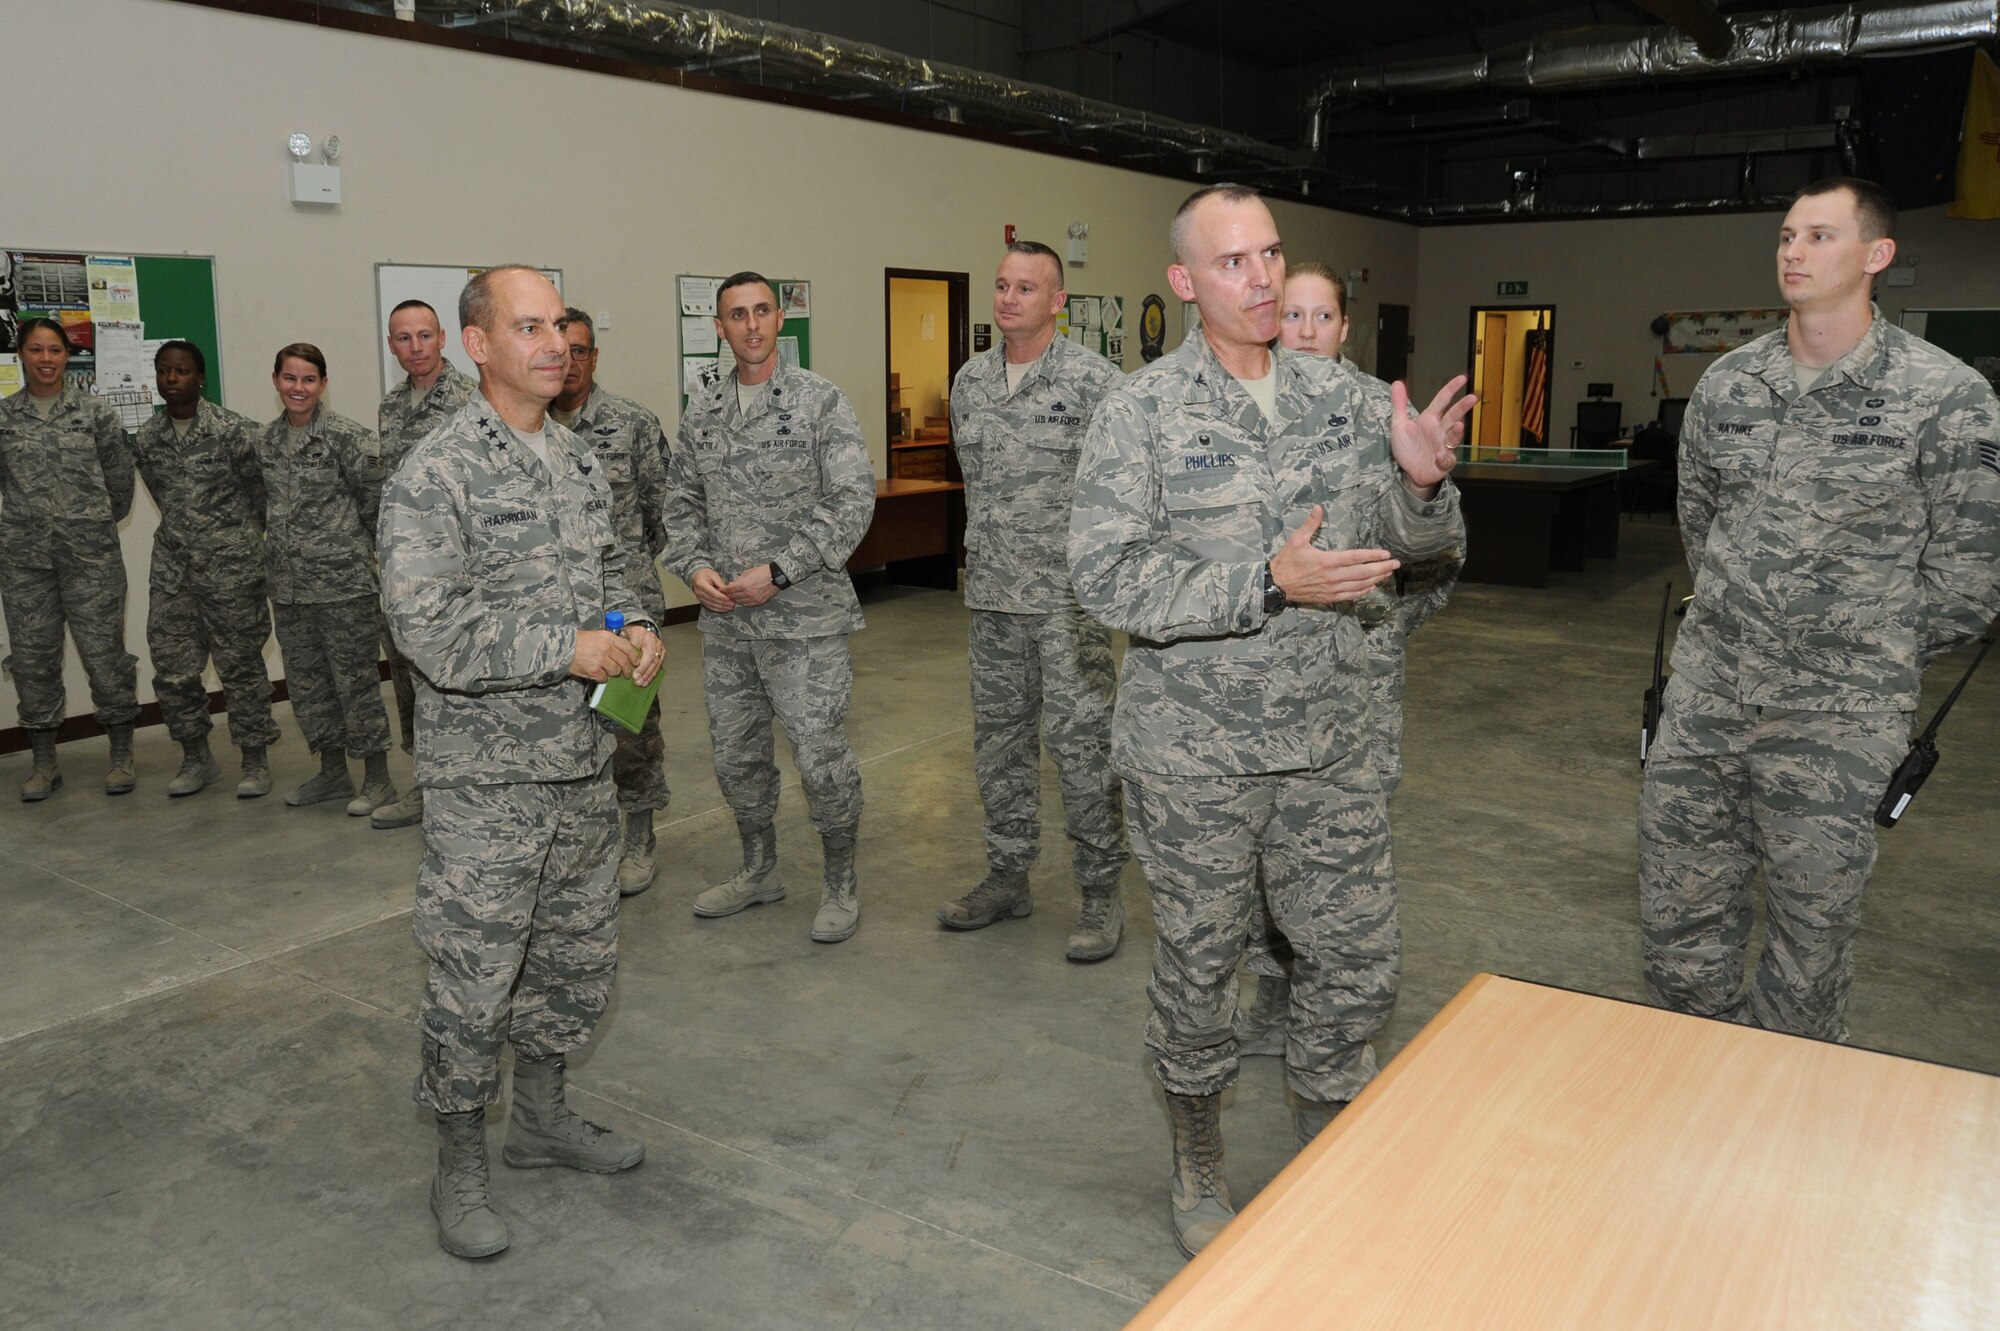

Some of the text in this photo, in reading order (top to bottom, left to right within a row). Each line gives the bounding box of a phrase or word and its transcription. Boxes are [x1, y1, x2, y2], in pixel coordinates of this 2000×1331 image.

[1048, 415, 1059, 424] AIR
[1060, 416, 1081, 426] FORCE
[1718, 423, 1753, 437] RATHKE
[774, 440, 784, 449] AIR
[785, 439, 807, 449] FORCE
[1337, 434, 1353, 449] AIR
[1850, 434, 1870, 446] AIR
[1870, 434, 1907, 450] FORCE
[606, 452, 626, 461] FORCE
[1185, 453, 1235, 470] PHILLIPS
[483, 510, 538, 528] HARRIGIAN
